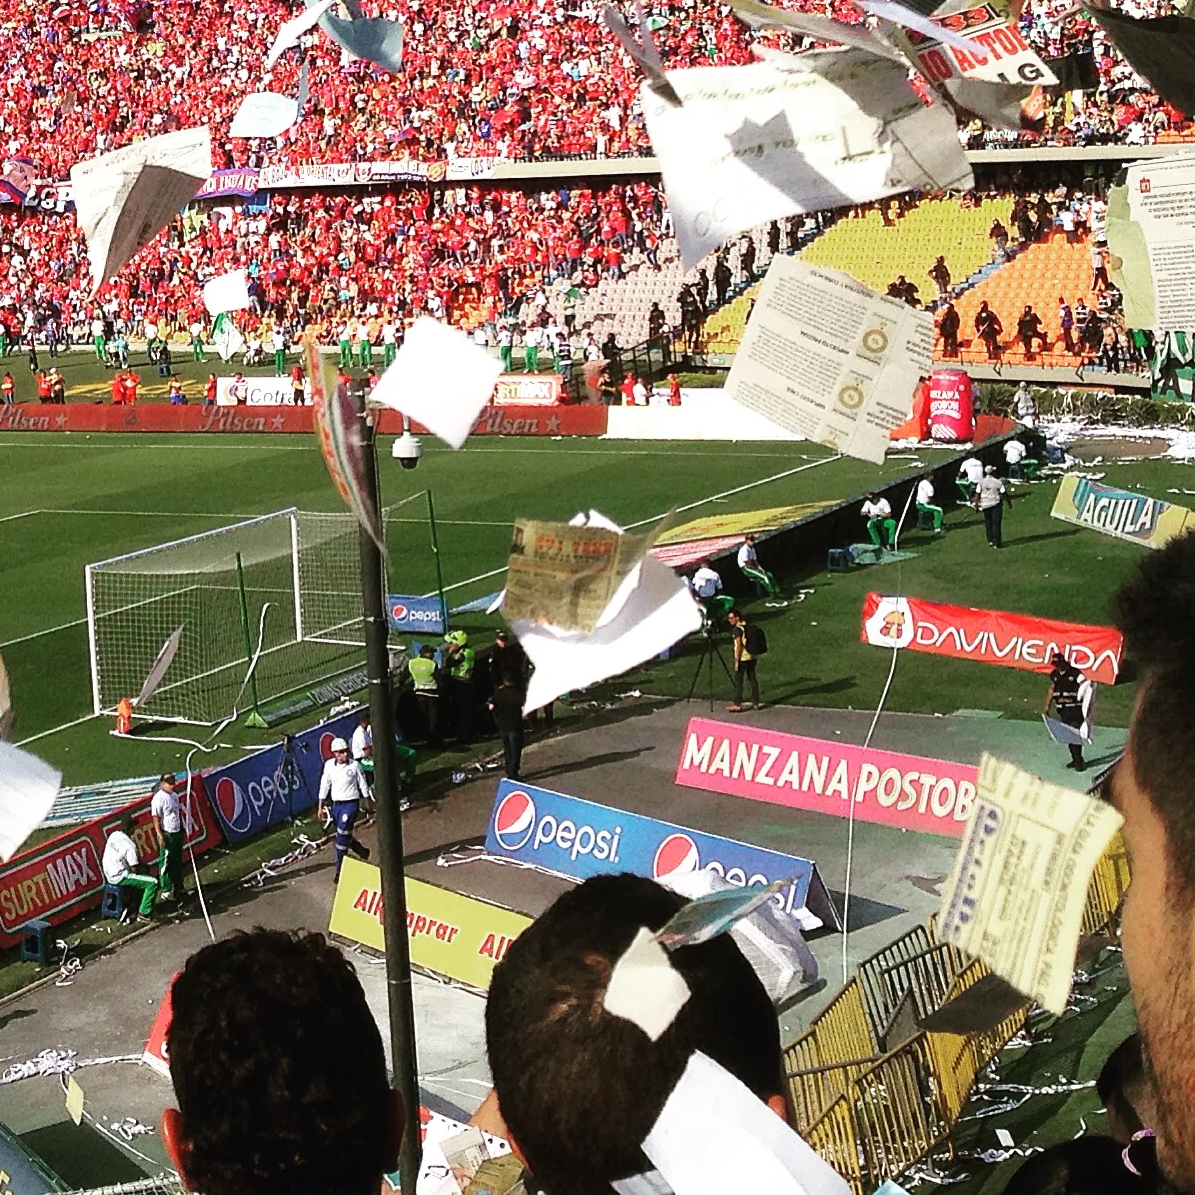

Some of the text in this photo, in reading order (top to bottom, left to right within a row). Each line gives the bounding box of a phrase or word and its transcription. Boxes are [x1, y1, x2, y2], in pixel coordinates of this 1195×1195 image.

[198, 405, 266, 432] Pilsen
[250, 387, 313, 405] Cotraa
[1080, 492, 1154, 533] AGUILA
[409, 610, 442, 622] pepsi
[916, 621, 1120, 675] DAVIVIENDA
[682, 732, 977, 822] MANZANA POSTOB
[533, 813, 622, 864] pepsi
[1, 847, 98, 922] SURTIMAX
